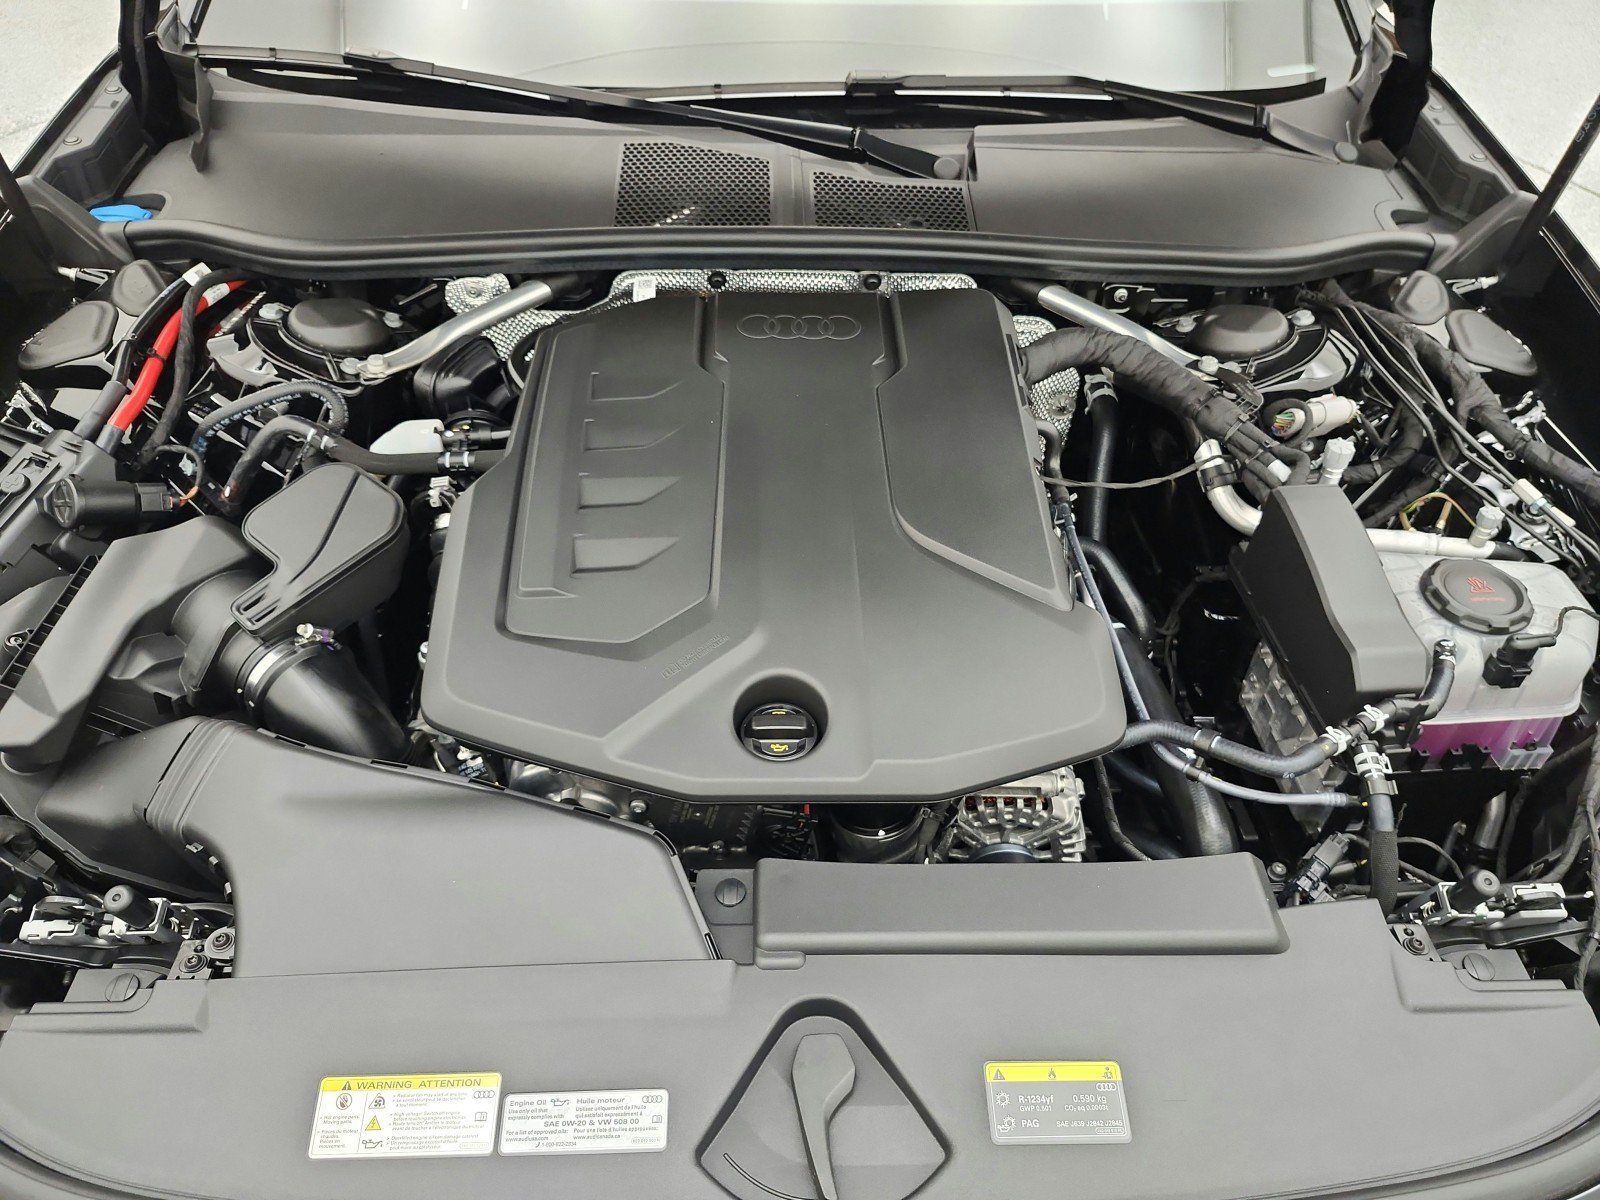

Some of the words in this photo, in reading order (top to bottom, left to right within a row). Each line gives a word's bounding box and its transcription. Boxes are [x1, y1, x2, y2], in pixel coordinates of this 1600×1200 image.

[357, 1081, 412, 1090] WARNING
[419, 1079, 481, 1088] ATTENTION
[1018, 1095, 1054, 1105] R-1234yf
[1072, 1095, 1095, 1103] 0.590
[1096, 1094, 1107, 1104] kg
[1021, 1120, 1040, 1128] PAG
